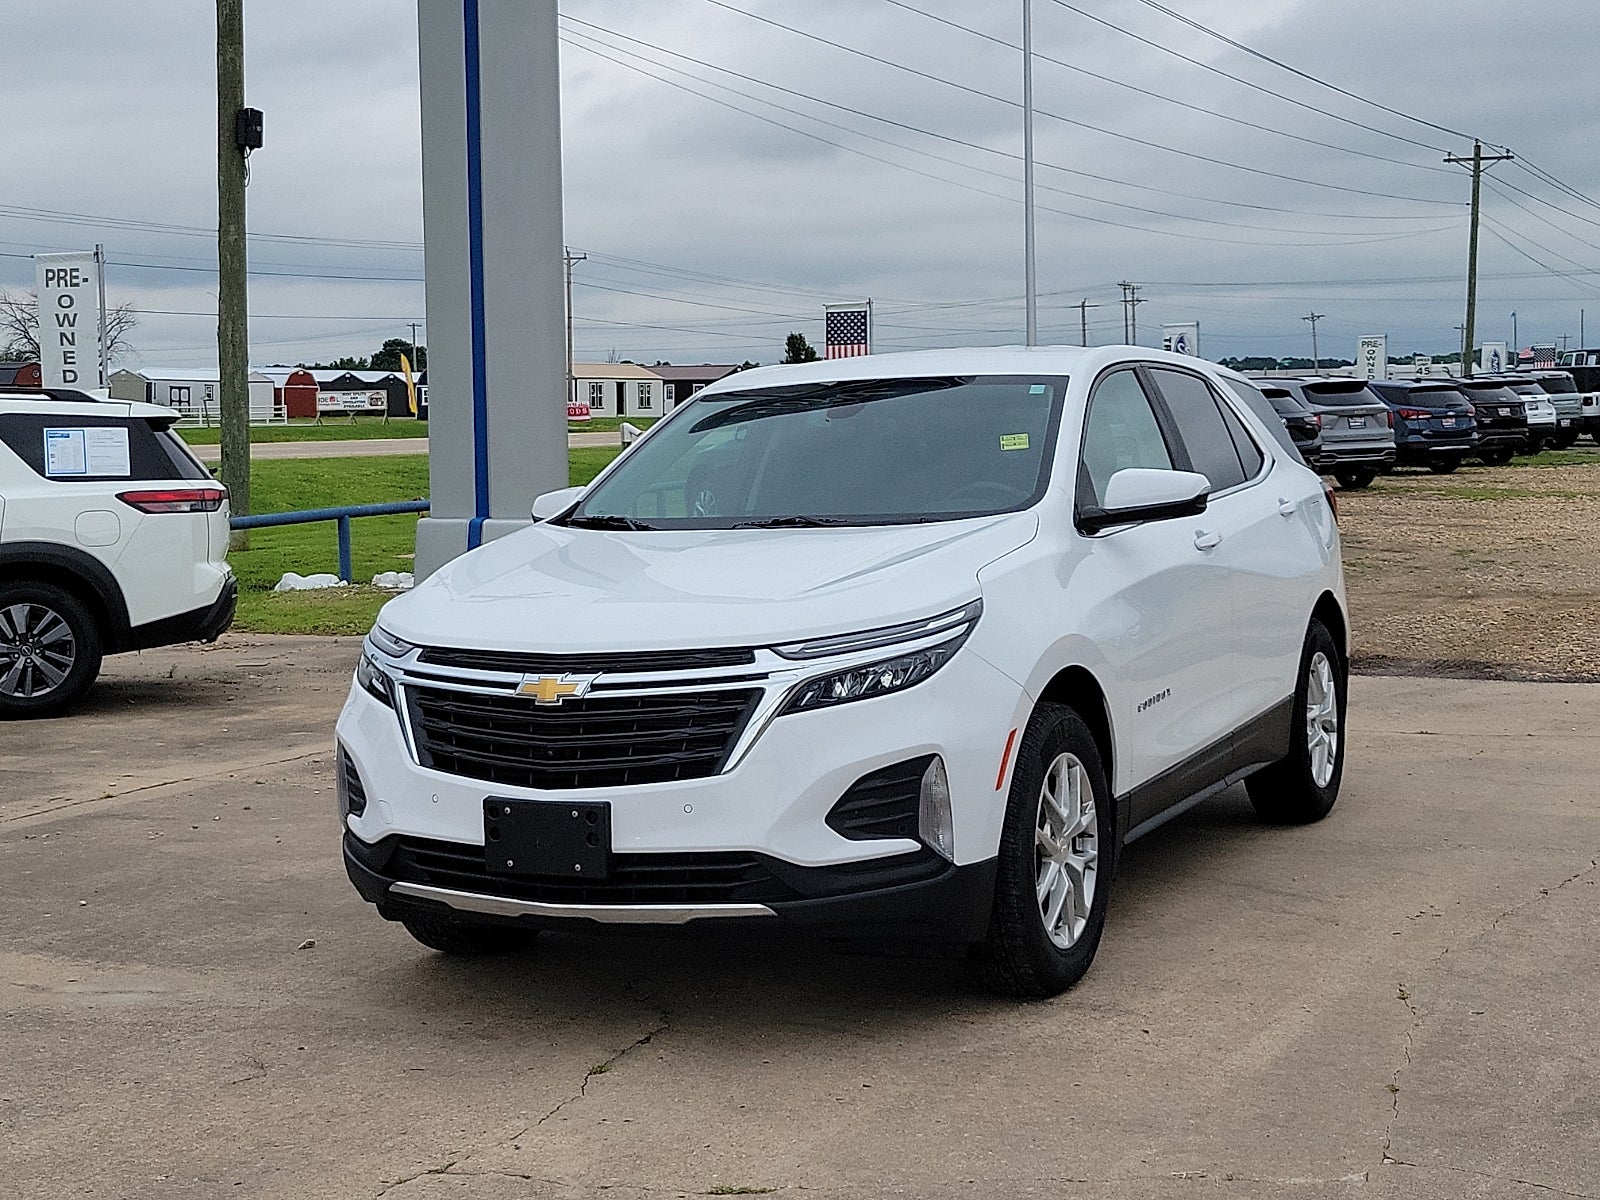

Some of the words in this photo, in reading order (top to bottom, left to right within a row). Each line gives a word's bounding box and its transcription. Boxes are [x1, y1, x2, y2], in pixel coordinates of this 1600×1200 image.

[45, 267, 89, 288] PRE-
[54, 293, 79, 384] OWNED
[1361, 340, 1382, 348] PRE-
[1365, 349, 1376, 380] OWNED
[1416, 367, 1431, 375] 45
